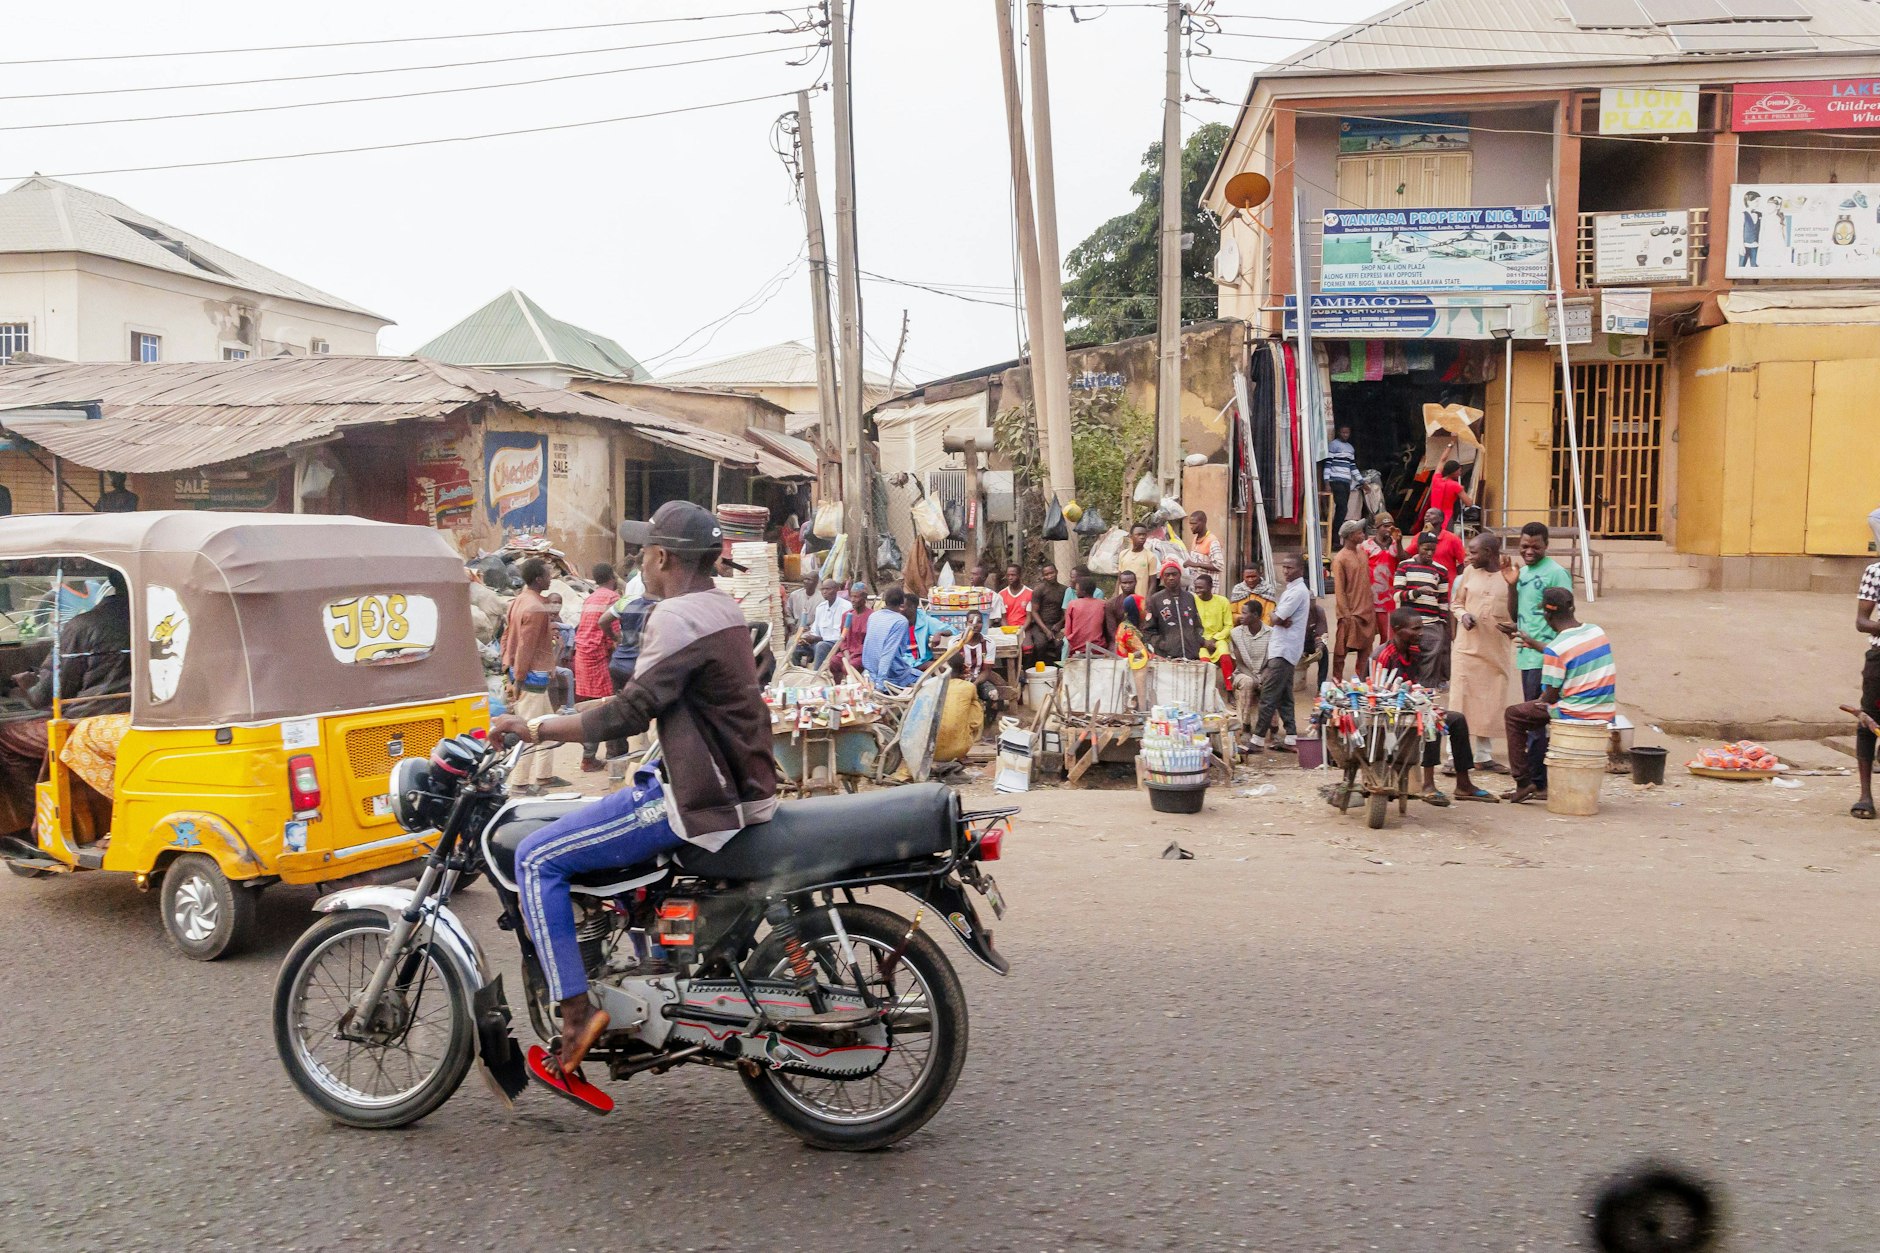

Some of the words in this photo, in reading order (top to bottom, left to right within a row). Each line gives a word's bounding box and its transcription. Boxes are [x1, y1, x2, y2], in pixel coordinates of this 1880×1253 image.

[1616, 88, 1683, 109] LION
[1832, 82, 1880, 97] LAKE
[1603, 110, 1694, 130] PLAZA
[1339, 213, 1407, 227] YANKARA
[1409, 210, 1482, 225] PROPERTY
[1485, 209, 1518, 223] NIG.
[1522, 209, 1550, 222] LTD.
[552, 460, 568, 473] SALE
[174, 479, 209, 494] SALE
[329, 593, 410, 650] JOS
